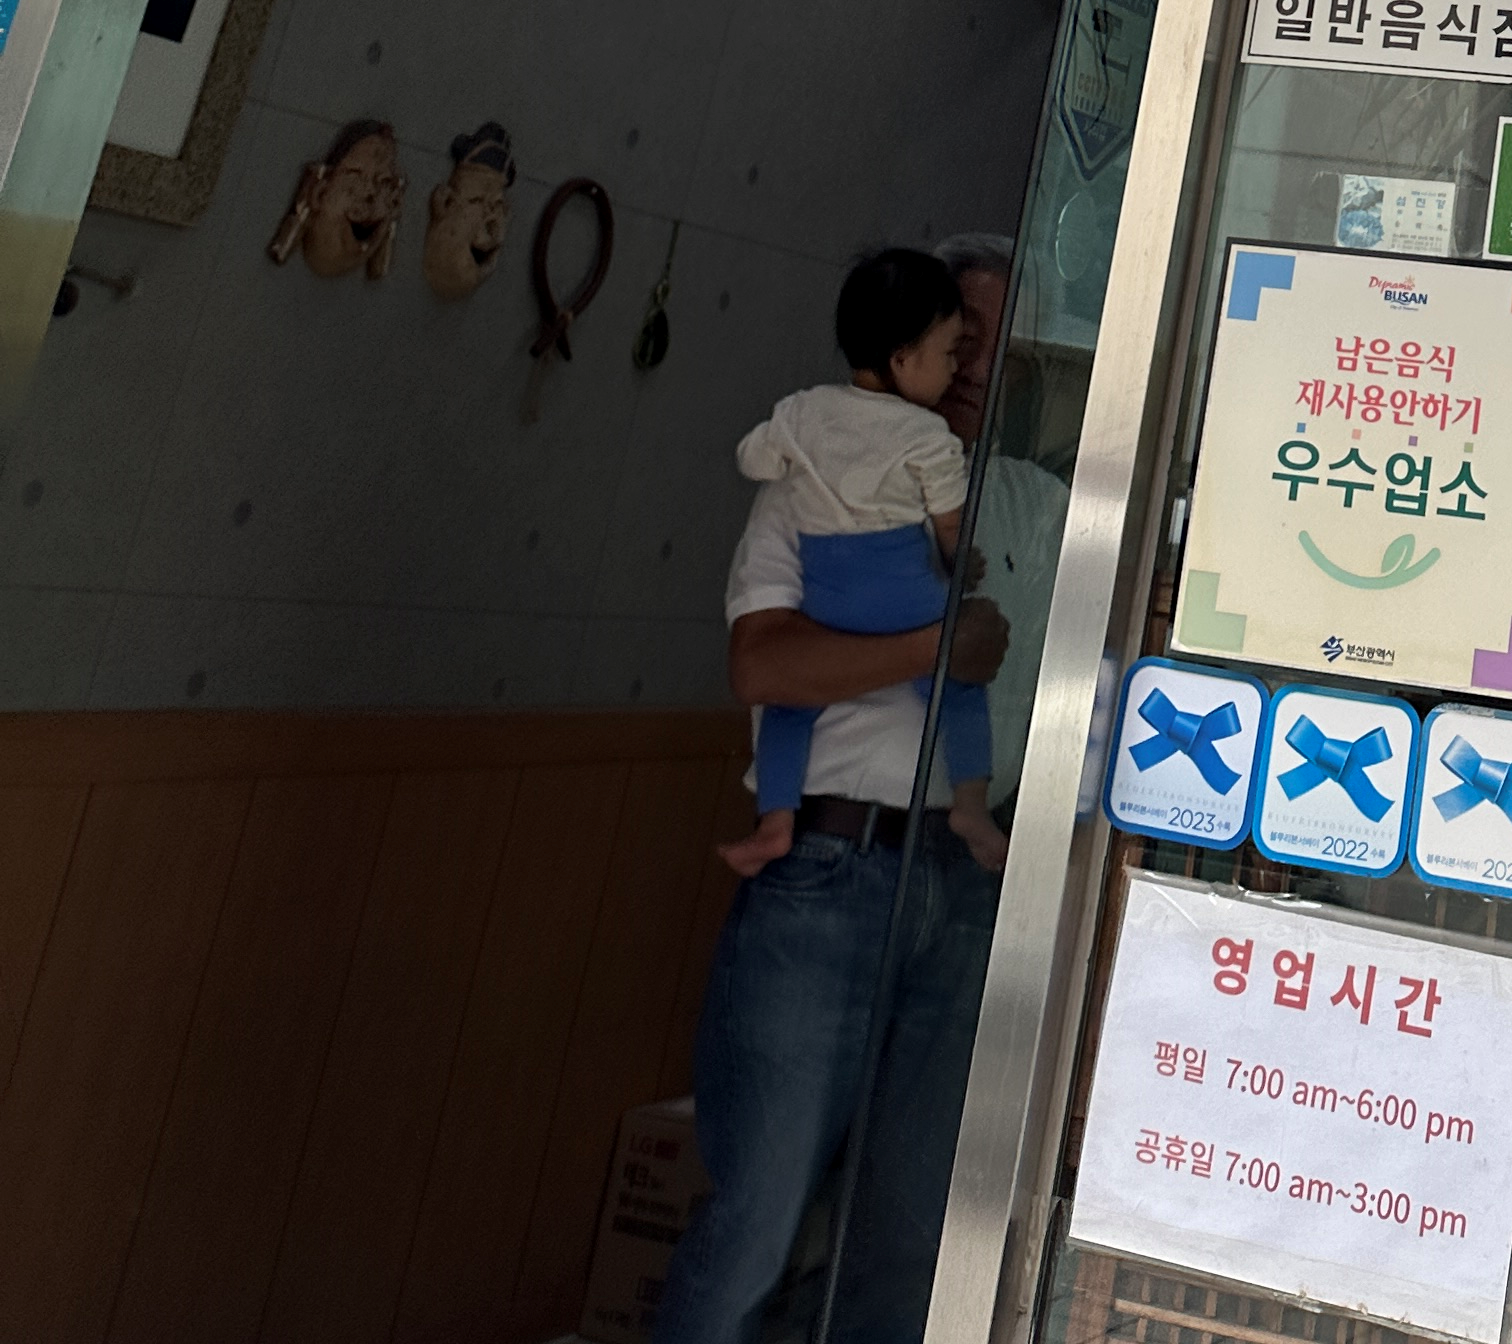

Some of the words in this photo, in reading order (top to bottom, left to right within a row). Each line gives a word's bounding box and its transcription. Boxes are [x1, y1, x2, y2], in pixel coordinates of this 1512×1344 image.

[1384, 290, 1428, 304] BUSAN
[1335, 335, 1457, 383] 남은음식
[1295, 378, 1483, 435] 재사용안하기
[1271, 440, 1488, 521] 우수업소
[1345, 643, 1396, 661] 부산광역시
[1168, 807, 1216, 832] 2023
[1322, 836, 1369, 862] 2022
[1211, 936, 1442, 1039] 영업시간
[1154, 1041, 1208, 1085] 평일
[1226, 1058, 1285, 1100] 7:00
[1292, 1078, 1417, 1132] am~6:00
[1425, 1109, 1475, 1145] pm
[1135, 1128, 1215, 1179] 공휴일
[1225, 1152, 1281, 1193] 7:00
[1288, 1173, 1411, 1225] am~3:00
[1419, 1202, 1468, 1239] pm
